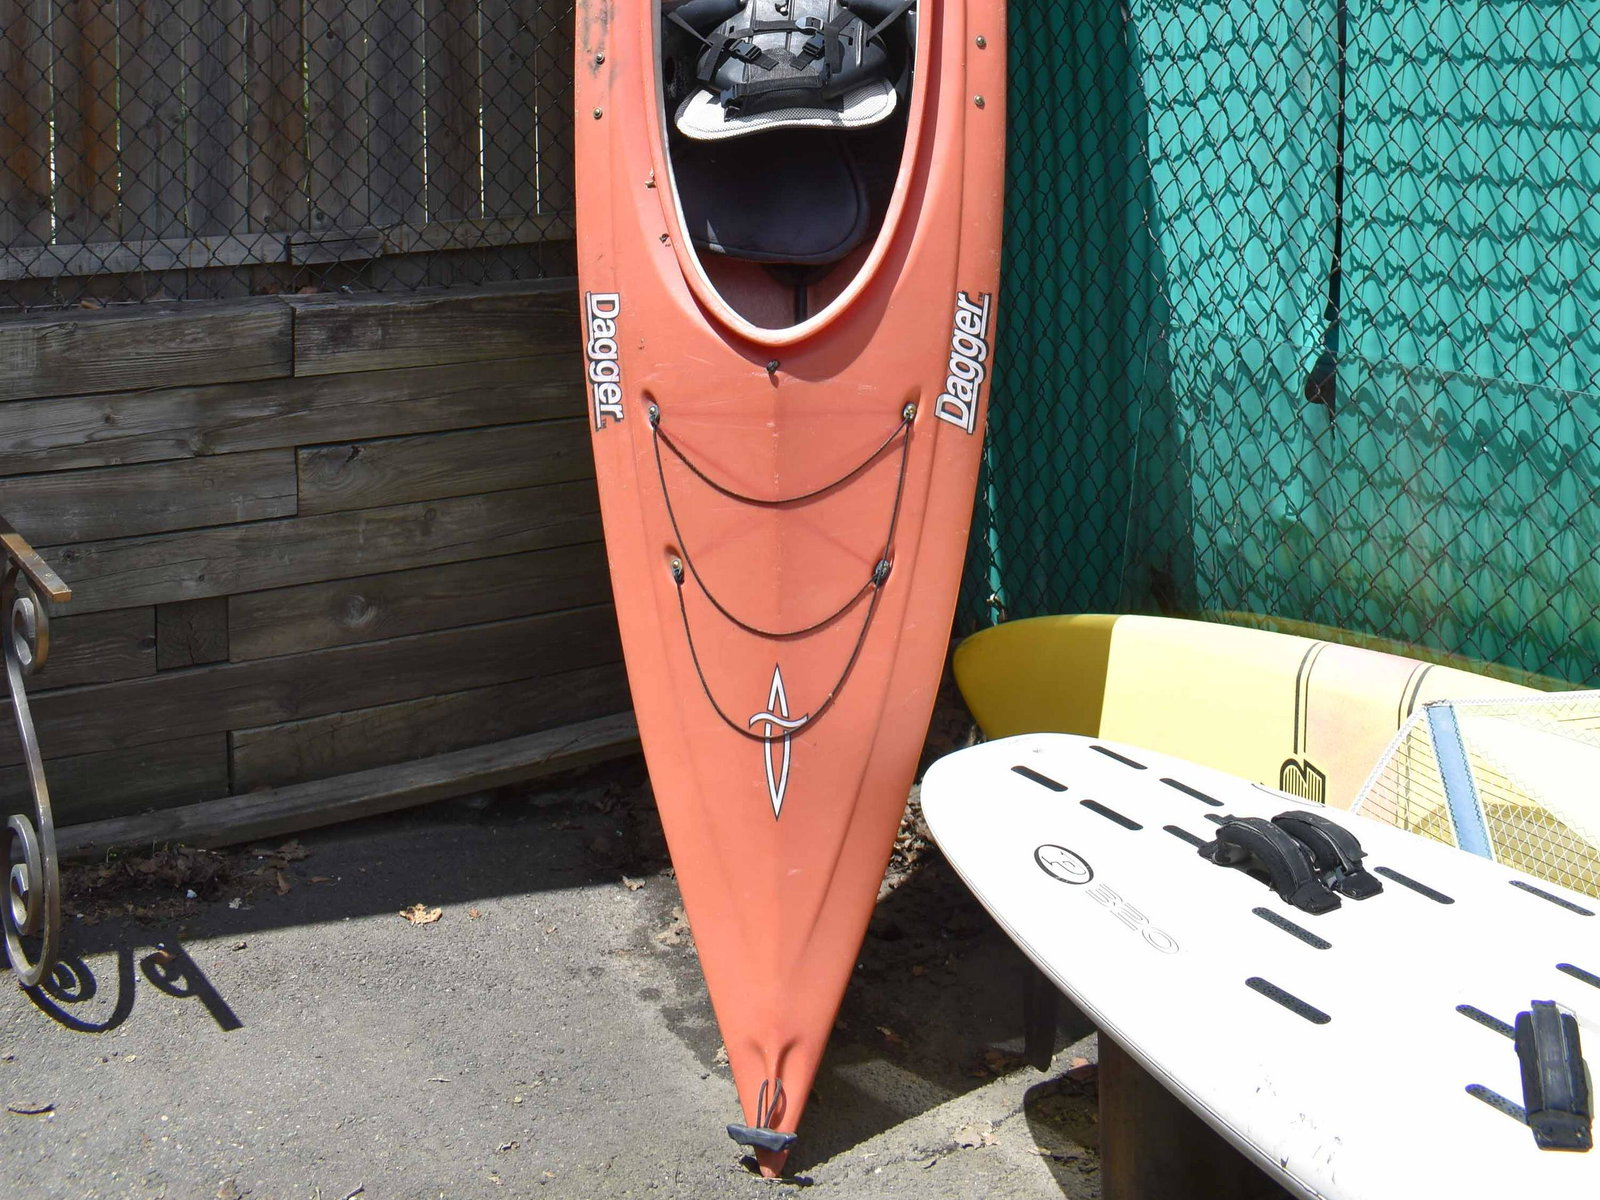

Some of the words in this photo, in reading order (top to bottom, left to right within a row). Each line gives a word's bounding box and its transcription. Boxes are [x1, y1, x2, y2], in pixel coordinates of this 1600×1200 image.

[585, 290, 624, 432] Dagger
[934, 289, 992, 435] Dagger
[1085, 883, 1180, 954] 320
